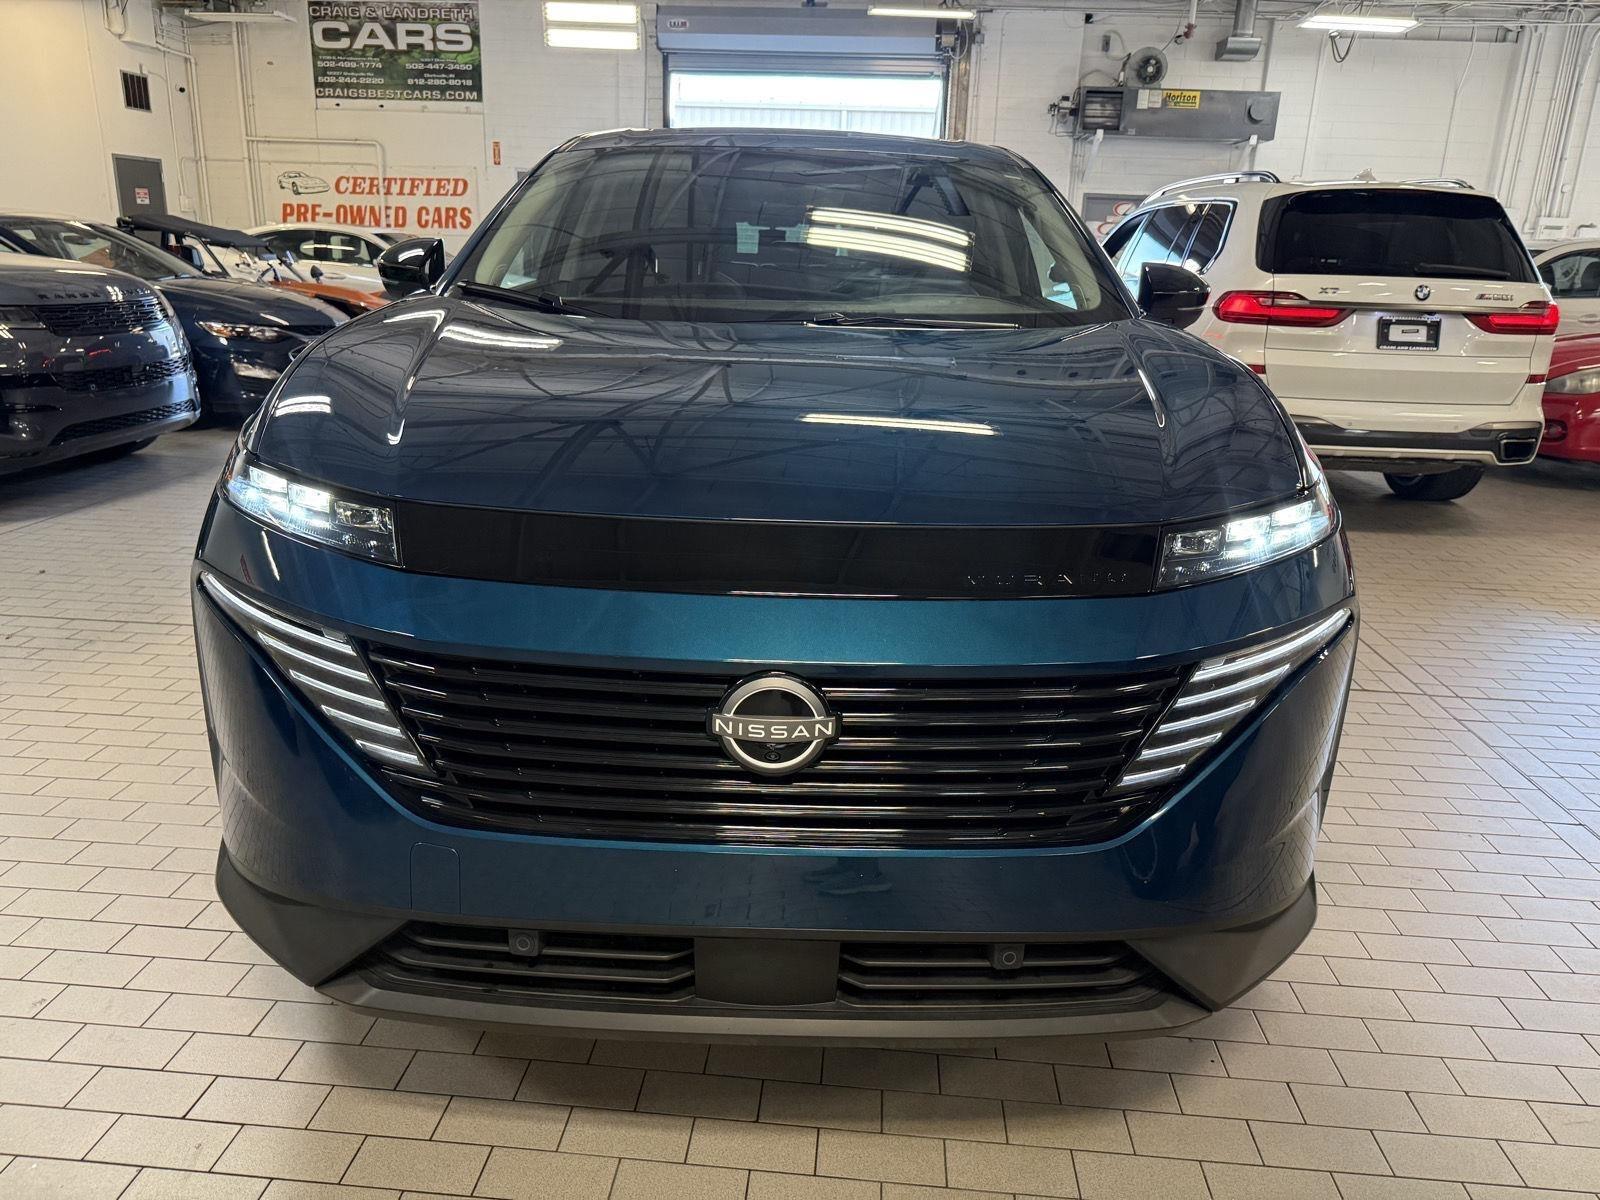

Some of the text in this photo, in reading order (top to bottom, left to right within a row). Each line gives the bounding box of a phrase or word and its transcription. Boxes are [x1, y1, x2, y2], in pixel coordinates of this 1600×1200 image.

[309, 6, 474, 19] CRAIG & LANDRETH
[312, 20, 473, 52] CARS
[316, 87, 478, 100] CRAIGSBESTCARS.COM
[335, 175, 469, 197] CERTIFIED
[282, 203, 473, 229] PRE-OWNED CARS
[715, 718, 833, 739] NISSAN
